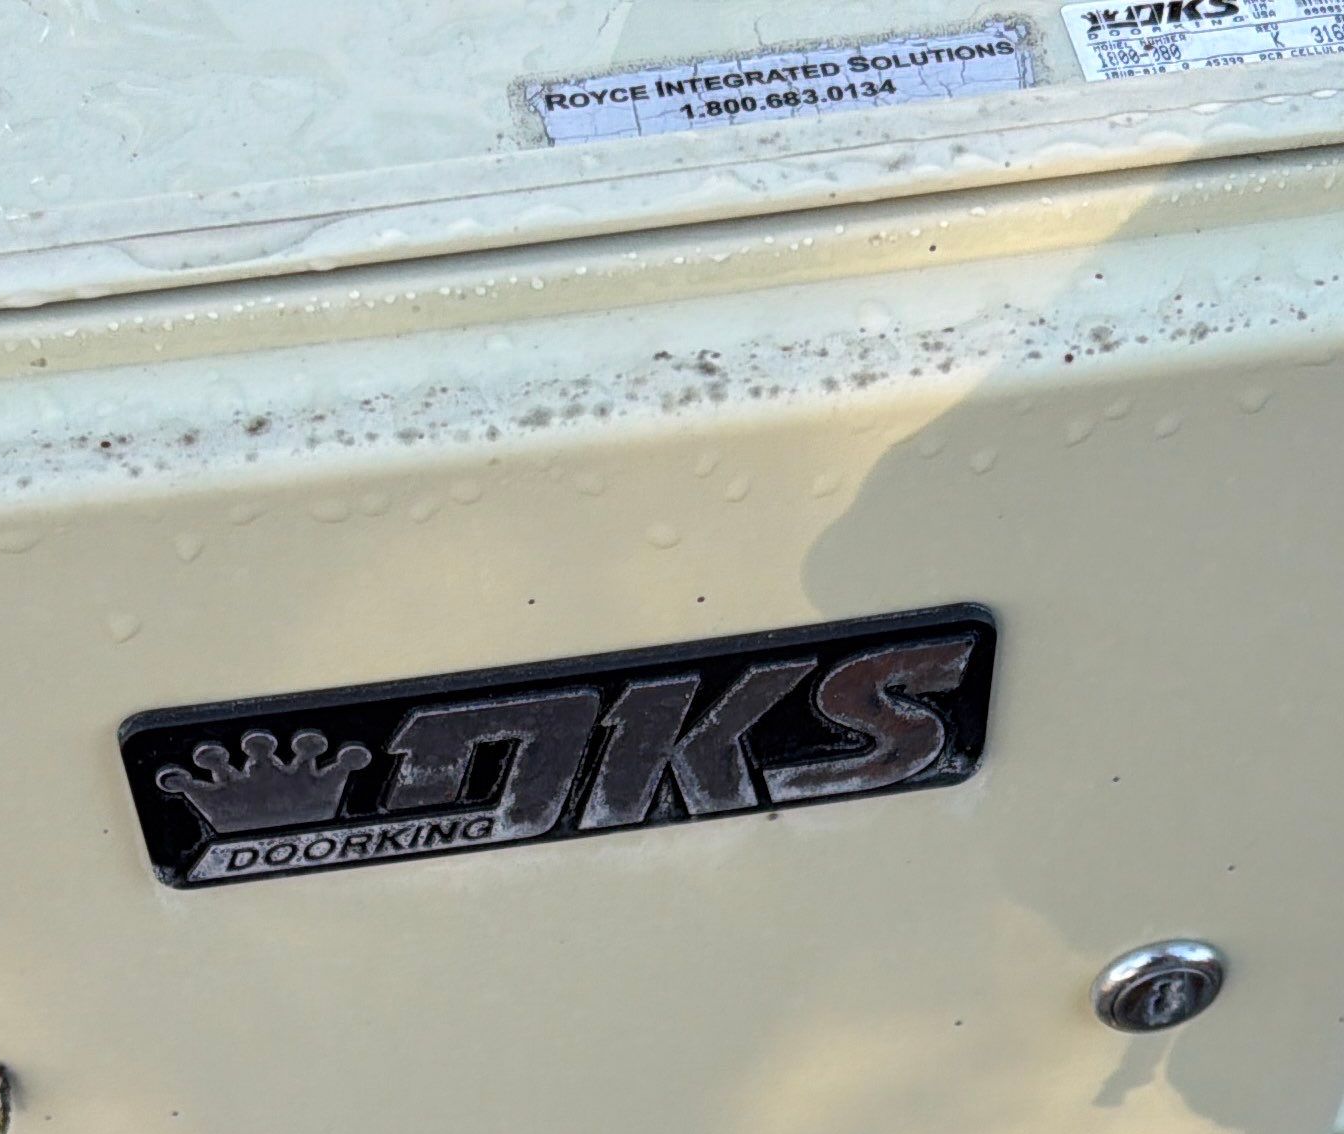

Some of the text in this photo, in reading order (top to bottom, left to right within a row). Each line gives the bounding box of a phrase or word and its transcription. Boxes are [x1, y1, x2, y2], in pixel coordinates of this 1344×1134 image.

[1253, 10, 1276, 19] USA
[1270, 31, 1285, 48] K
[545, 41, 1016, 112] ROYCE INTEGRATED SOLUTIONS
[679, 77, 898, 120] 1.800.683.0134
[224, 815, 497, 874] DOORKING
